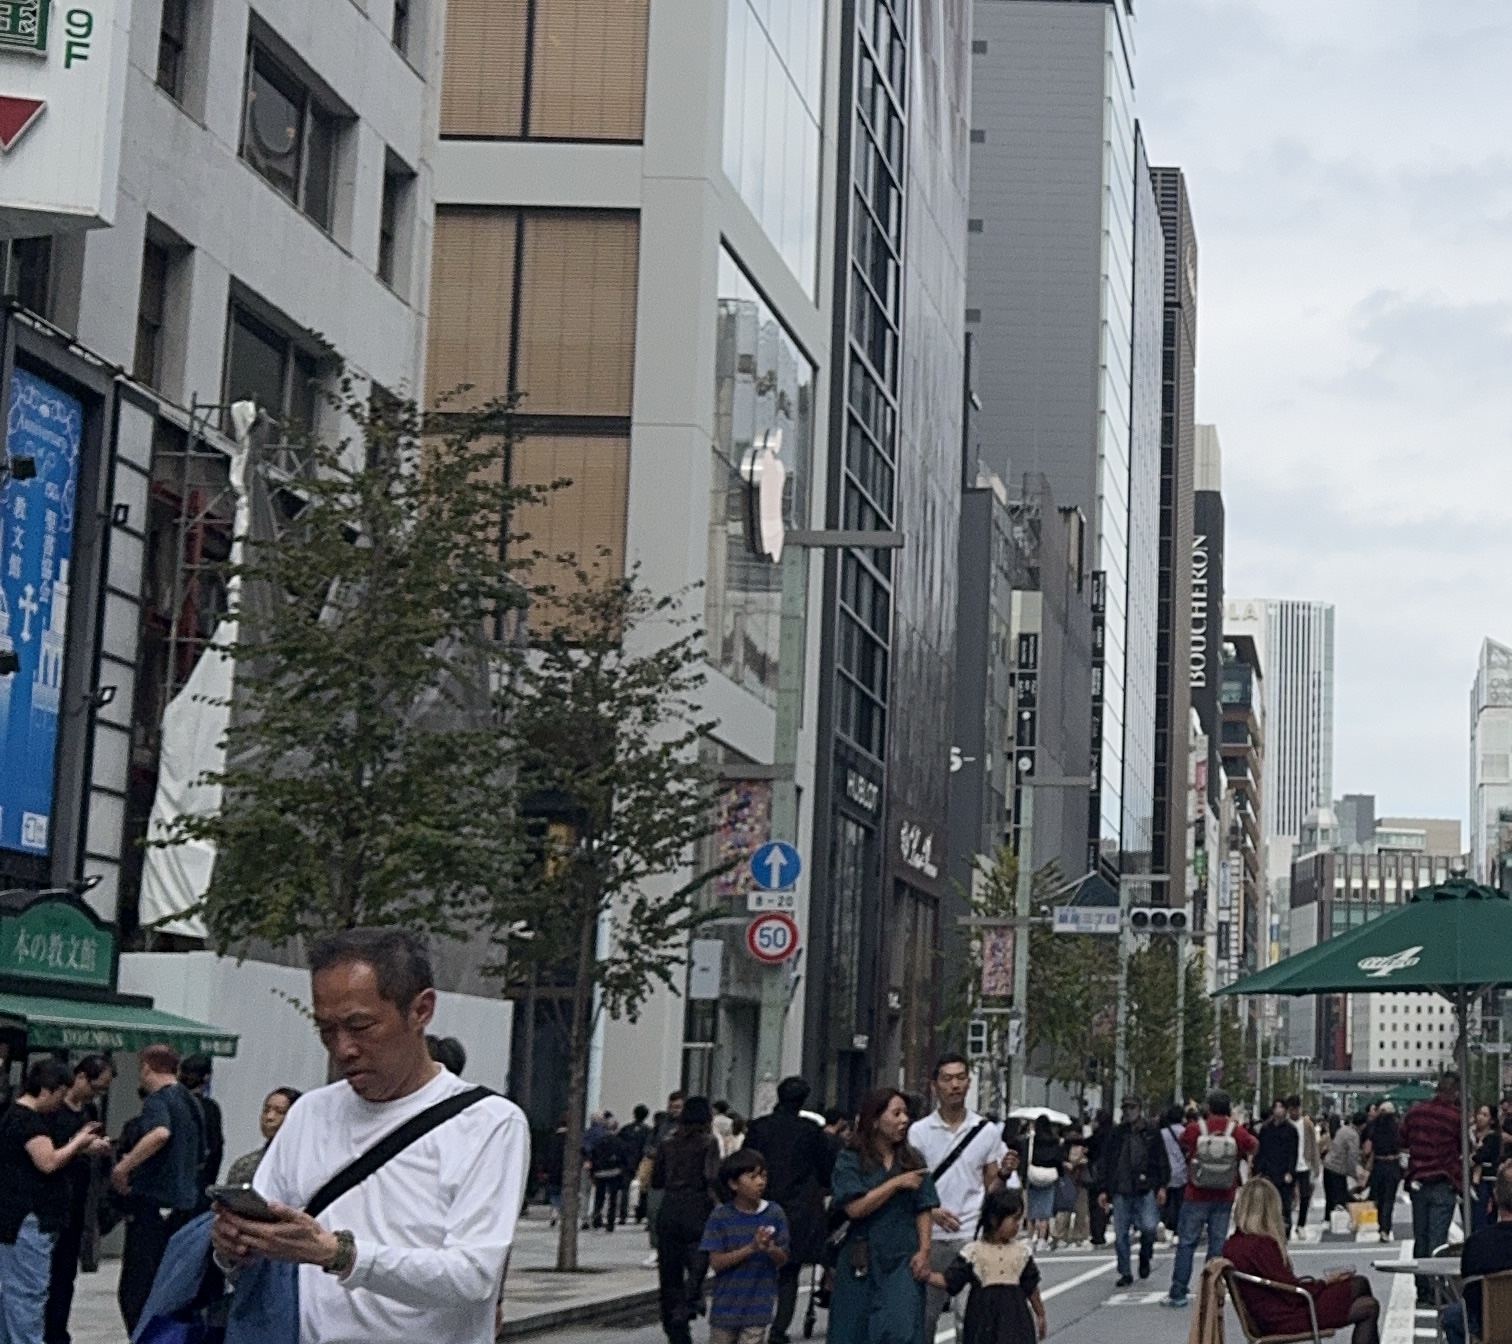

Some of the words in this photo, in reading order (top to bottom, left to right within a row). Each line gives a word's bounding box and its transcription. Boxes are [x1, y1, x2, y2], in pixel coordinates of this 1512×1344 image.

[63, 8, 94, 70] 9F
[1189, 534, 1209, 688] BOUCHERON
[14, 927, 97, 973] 本の教文館
[758, 926, 788, 949] 50
